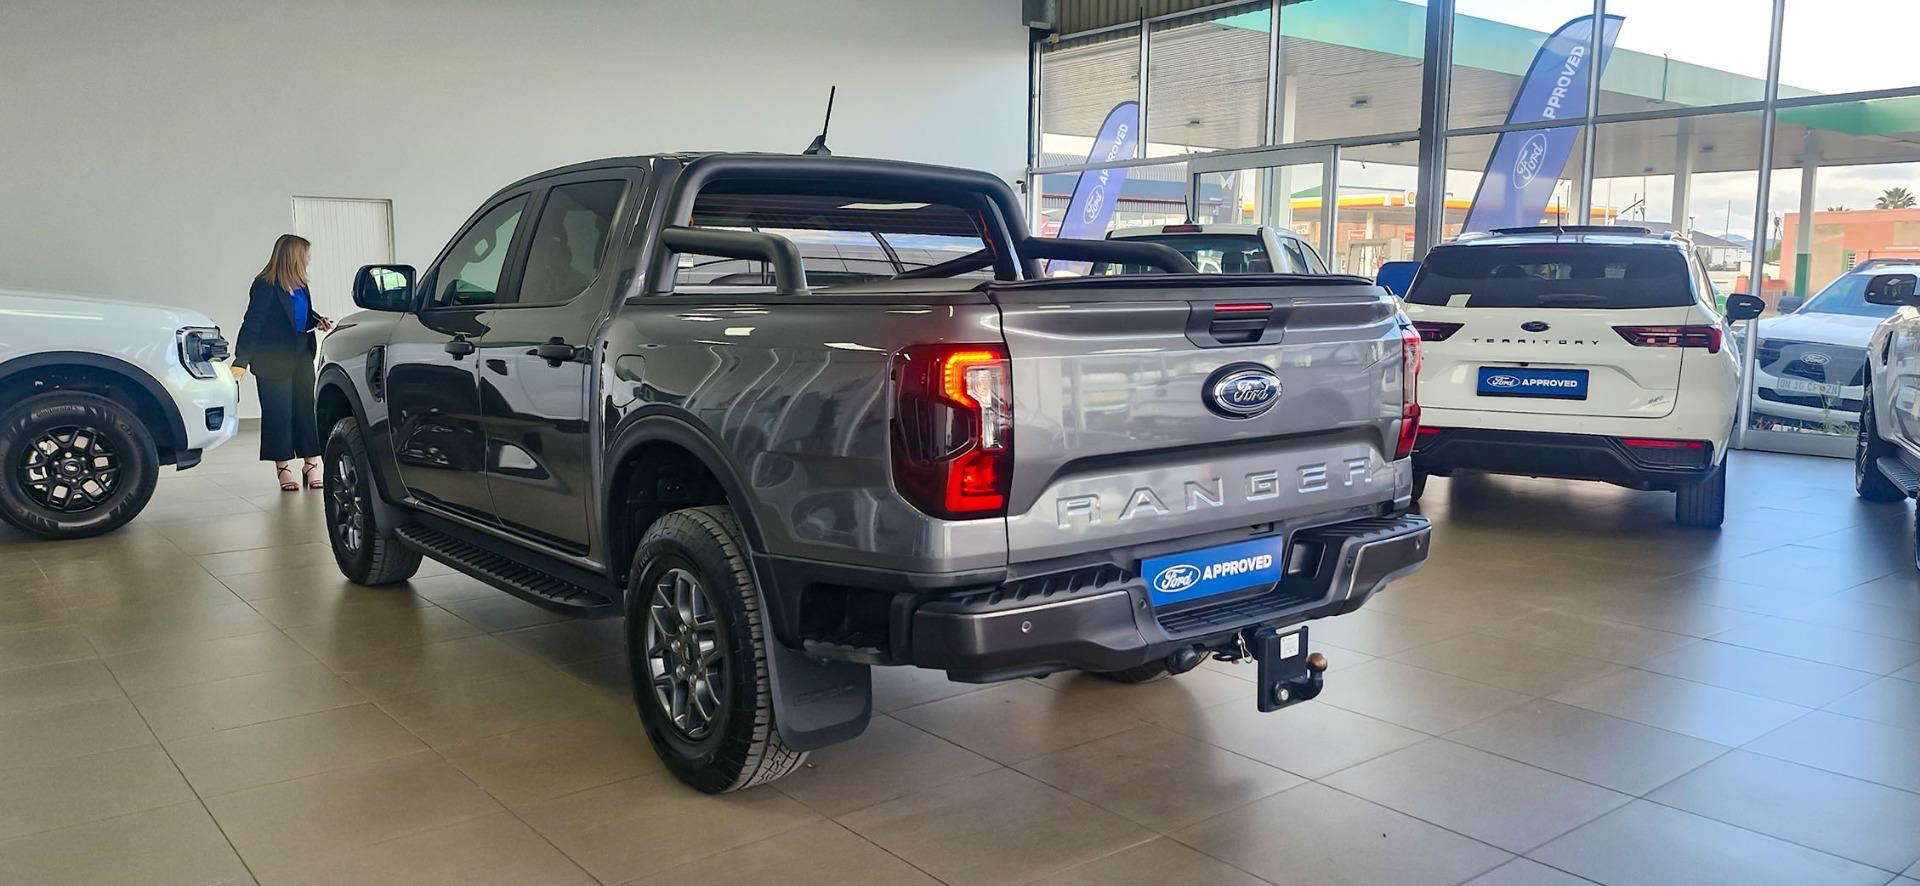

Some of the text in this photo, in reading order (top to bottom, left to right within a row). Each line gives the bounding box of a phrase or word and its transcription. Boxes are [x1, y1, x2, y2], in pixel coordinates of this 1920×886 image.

[1517, 45, 1585, 180] Ford PPROVED
[1086, 191, 1102, 219] Ford
[1233, 379, 1269, 403] Ford
[1492, 376, 1578, 387] Ford APPROVED
[1056, 457, 1372, 529] RANGER
[1161, 554, 1273, 590] Ford APPROVED
